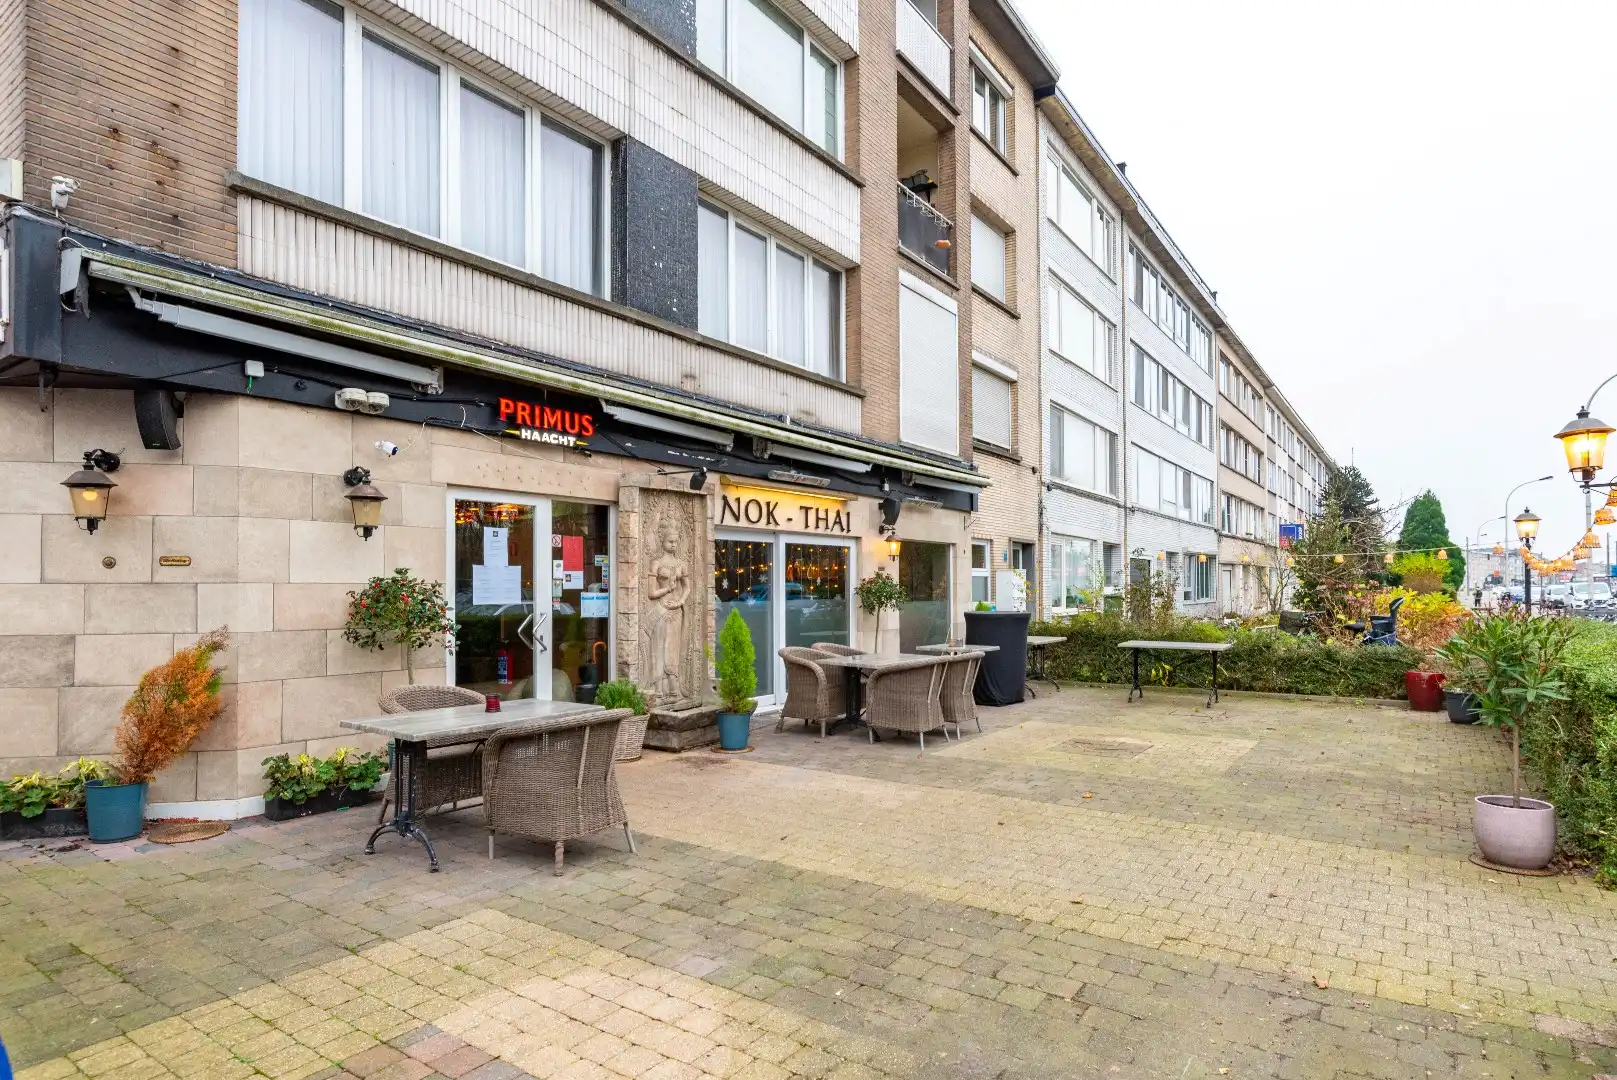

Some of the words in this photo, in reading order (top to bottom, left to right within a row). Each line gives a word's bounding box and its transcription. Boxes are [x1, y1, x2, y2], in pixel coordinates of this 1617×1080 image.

[499, 397, 594, 437] PRIMUS
[521, 428, 577, 447] HAACHT
[720, 494, 780, 526] NOK
[799, 505, 852, 534] THAI
